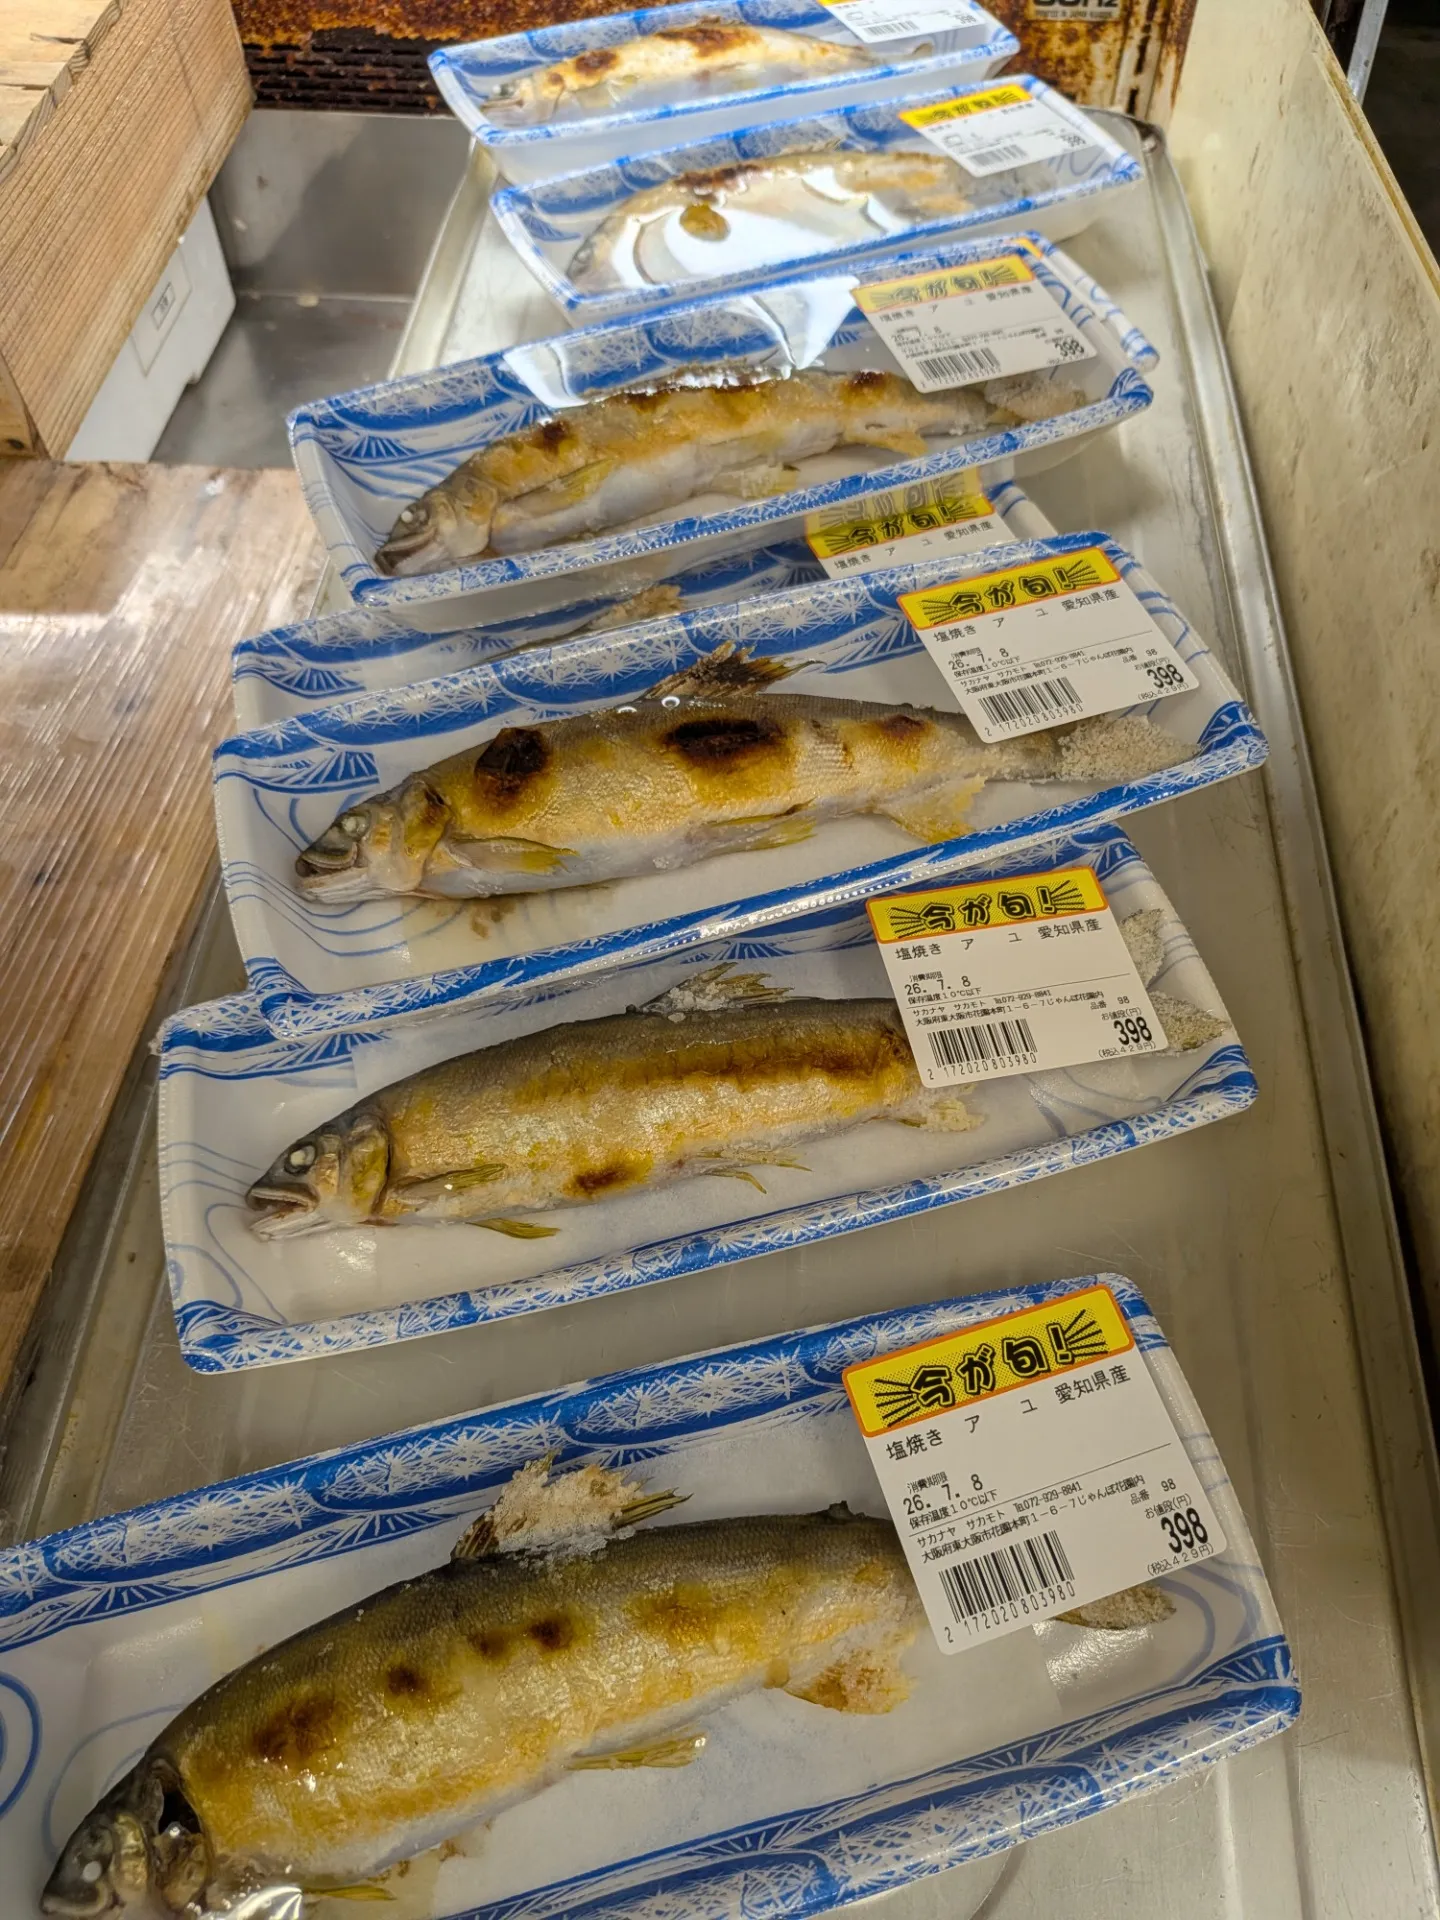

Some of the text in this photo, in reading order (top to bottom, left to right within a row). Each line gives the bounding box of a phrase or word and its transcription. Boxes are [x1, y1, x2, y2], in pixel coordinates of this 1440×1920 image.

[851, 505, 957, 546] 今が旬!
[884, 546, 897, 557] ア
[920, 537, 933, 547] ユ
[943, 520, 994, 542] 愛知県産
[949, 567, 1075, 615] 今が旬!
[933, 587, 1121, 643] 塩焼き ア ユ 愛知県産
[948, 647, 1009, 671] 26. 7. 8
[1146, 648, 1158, 657] 98
[1146, 663, 1185, 689] 398
[919, 886, 1058, 931] 今が旬!
[895, 918, 1103, 961] 塩焼き ア ユ 愛知県産
[904, 975, 972, 996] 26. 7. 8
[1117, 995, 1130, 1005] 98
[912, 1006, 946, 1018] サカナヤ
[953, 1000, 987, 1011] サカモト
[1112, 1016, 1153, 1046] 398
[909, 1322, 1075, 1408] 今が旬!
[885, 1364, 1132, 1461] 塩焼き ア ユ 愛知県産
[902, 1473, 984, 1516] 26. 7. 8
[906, 1471, 949, 1495] 消費期限
[1130, 1477, 1177, 1506] 品番 98
[1144, 1492, 1193, 1520] お値段(円)
[917, 1526, 956, 1549] サカナヤ
[966, 1509, 1006, 1531] サカモト
[1160, 1506, 1209, 1555] 398
[1146, 1542, 1214, 1577] (税込429円)
